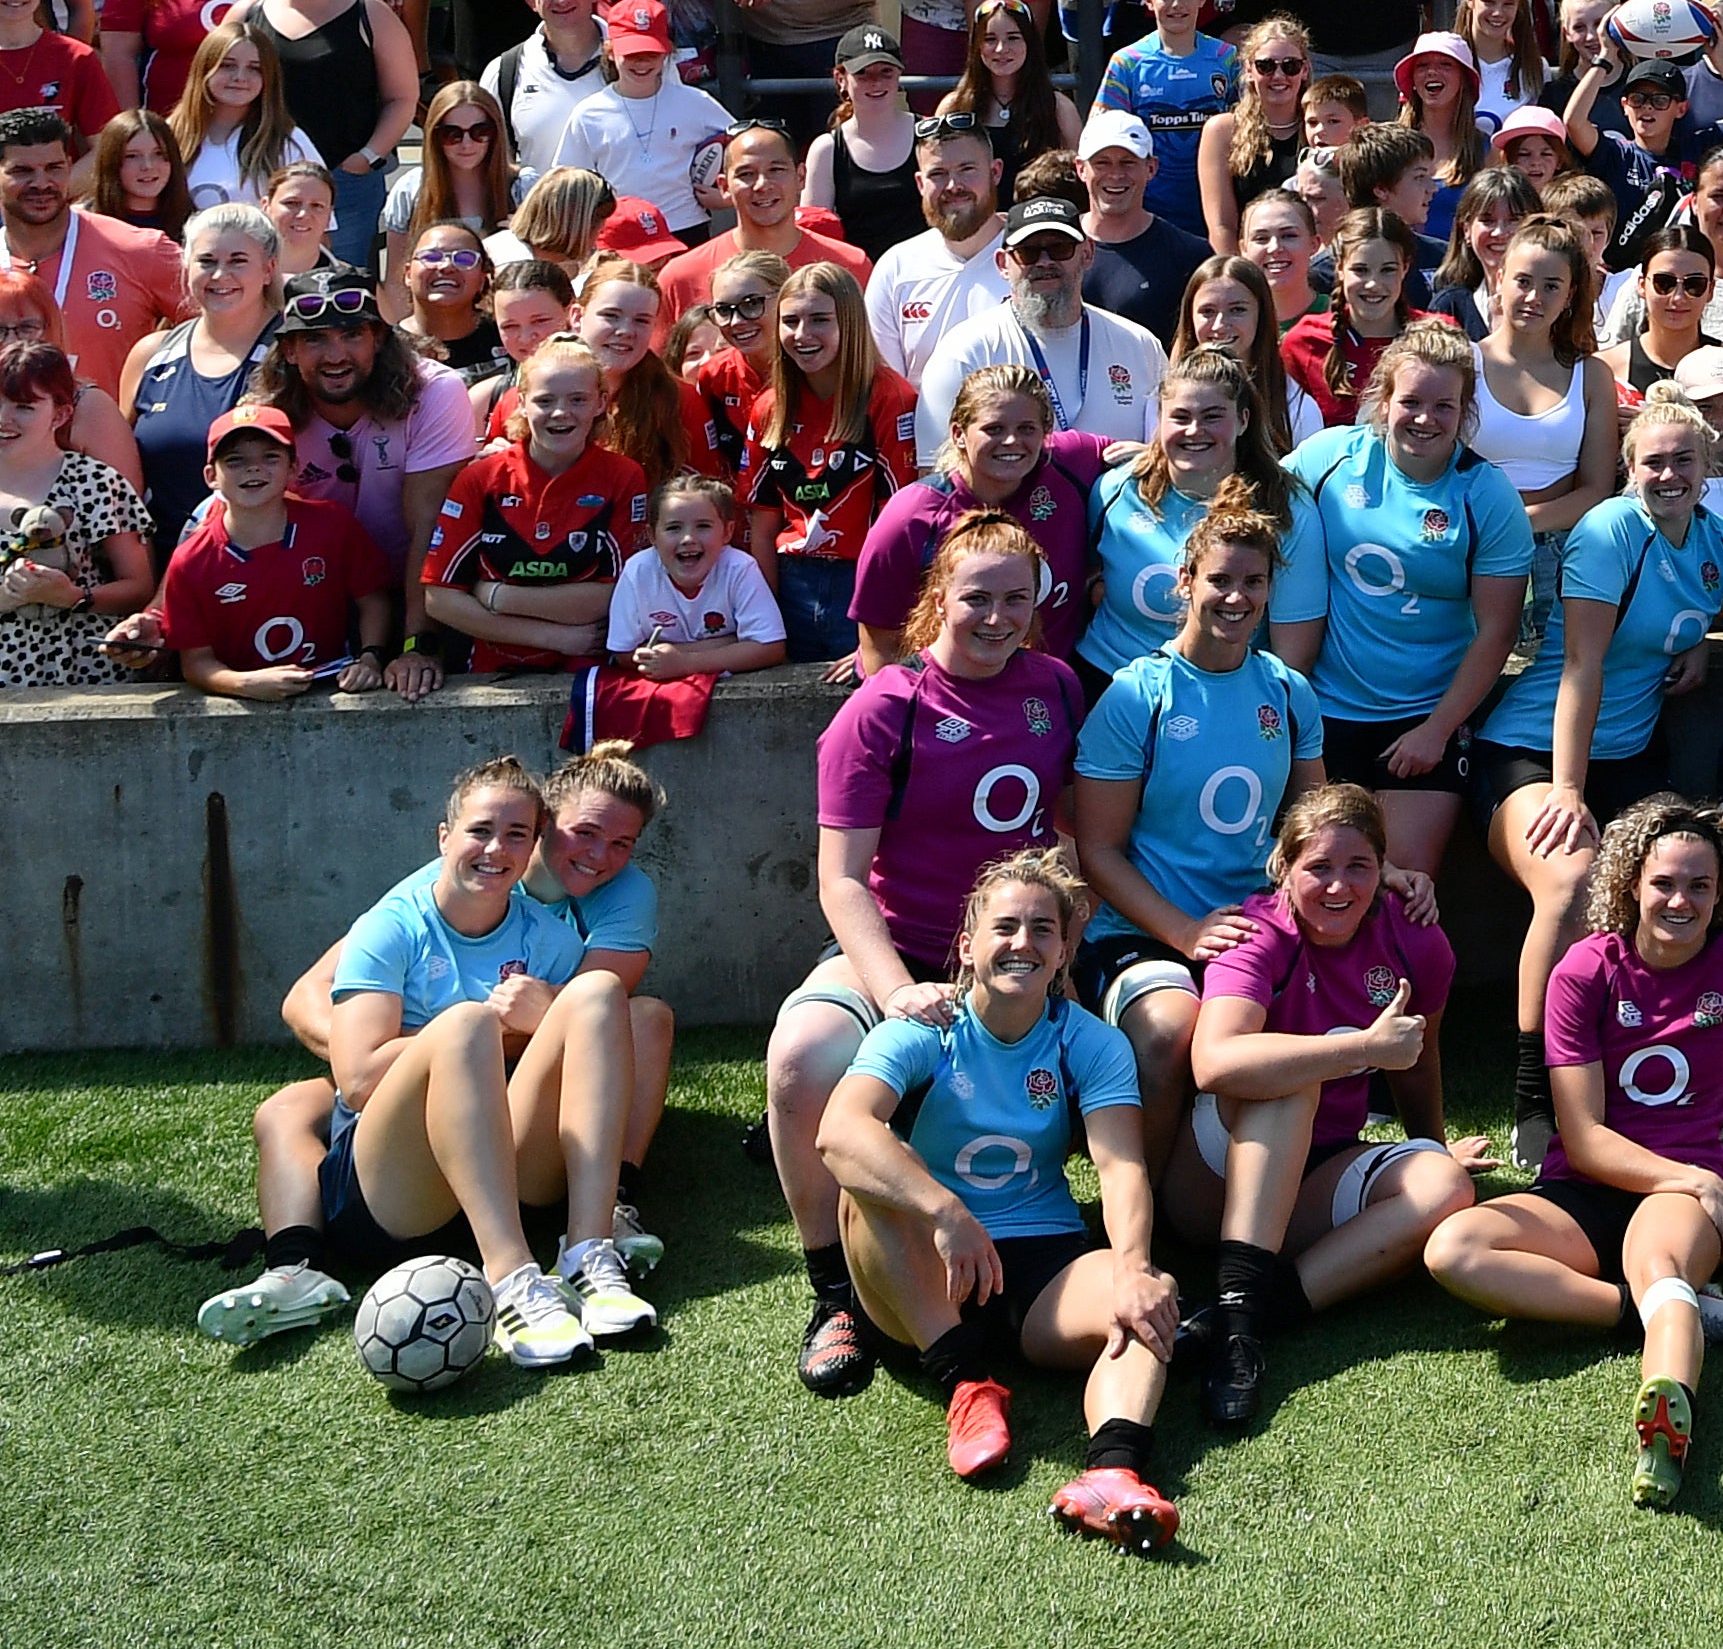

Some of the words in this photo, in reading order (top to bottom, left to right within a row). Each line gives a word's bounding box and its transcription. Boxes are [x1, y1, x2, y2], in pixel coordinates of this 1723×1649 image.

[1150, 112, 1189, 128] Topps
[1618, 192, 1658, 243] adidas
[96, 308, 121, 330] O2
[508, 560, 567, 579] ASDA
[1343, 540, 1418, 612] O2
[254, 615, 314, 663] O2
[972, 762, 1046, 839] O2
[1199, 763, 1268, 848] O2
